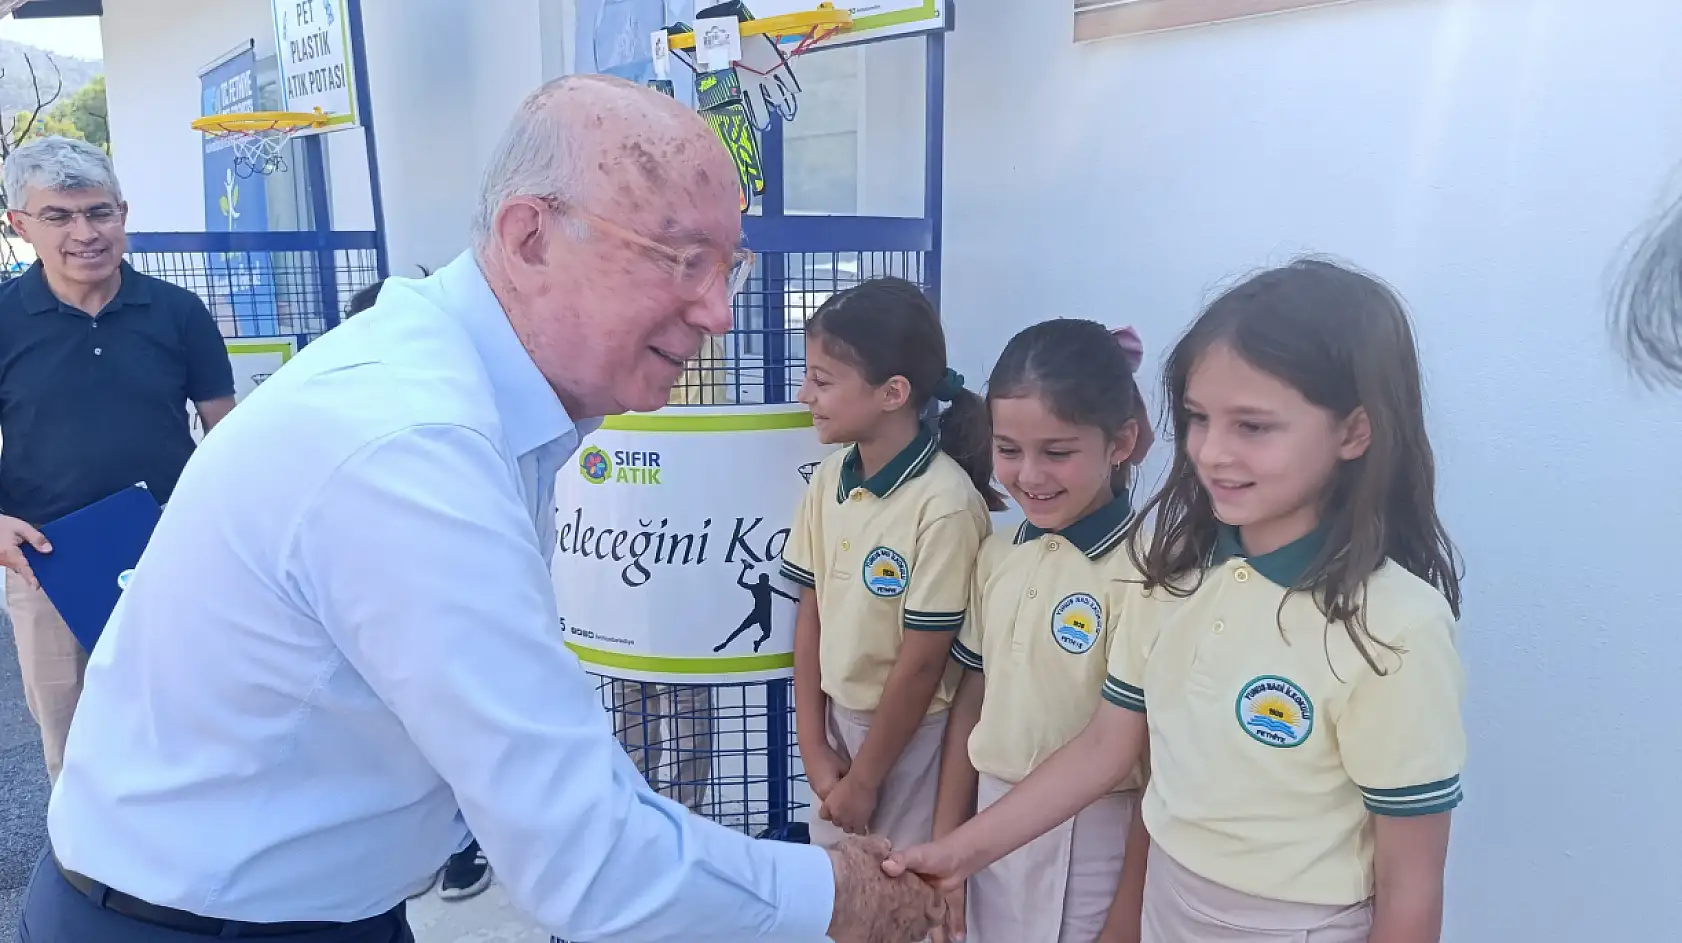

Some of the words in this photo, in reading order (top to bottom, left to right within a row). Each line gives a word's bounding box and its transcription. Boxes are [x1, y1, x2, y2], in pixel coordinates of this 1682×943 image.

[296, 0, 313, 26] PET
[290, 26, 330, 63] PLASTİK
[287, 73, 309, 99] ATIK
[308, 63, 346, 95] POTASI
[614, 450, 661, 467] SIFIR
[616, 467, 662, 485] ATIK
[555, 507, 712, 587] eleceğini
